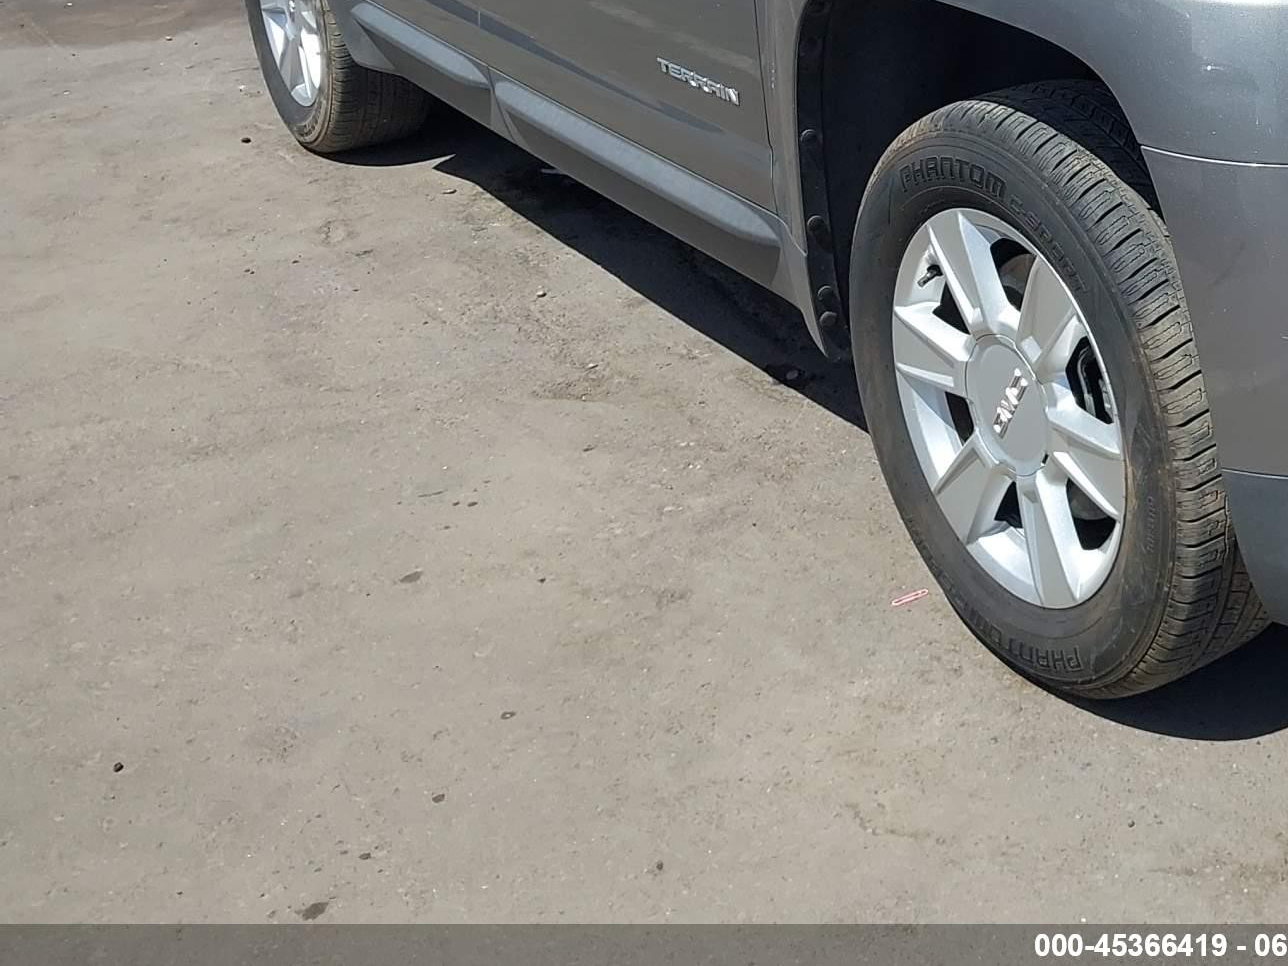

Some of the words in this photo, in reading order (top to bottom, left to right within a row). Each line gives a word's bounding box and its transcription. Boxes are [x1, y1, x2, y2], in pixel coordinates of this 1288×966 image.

[656, 56, 740, 106] TERRAIN
[900, 155, 1007, 201] PHANTOM
[992, 367, 1029, 439] GMC
